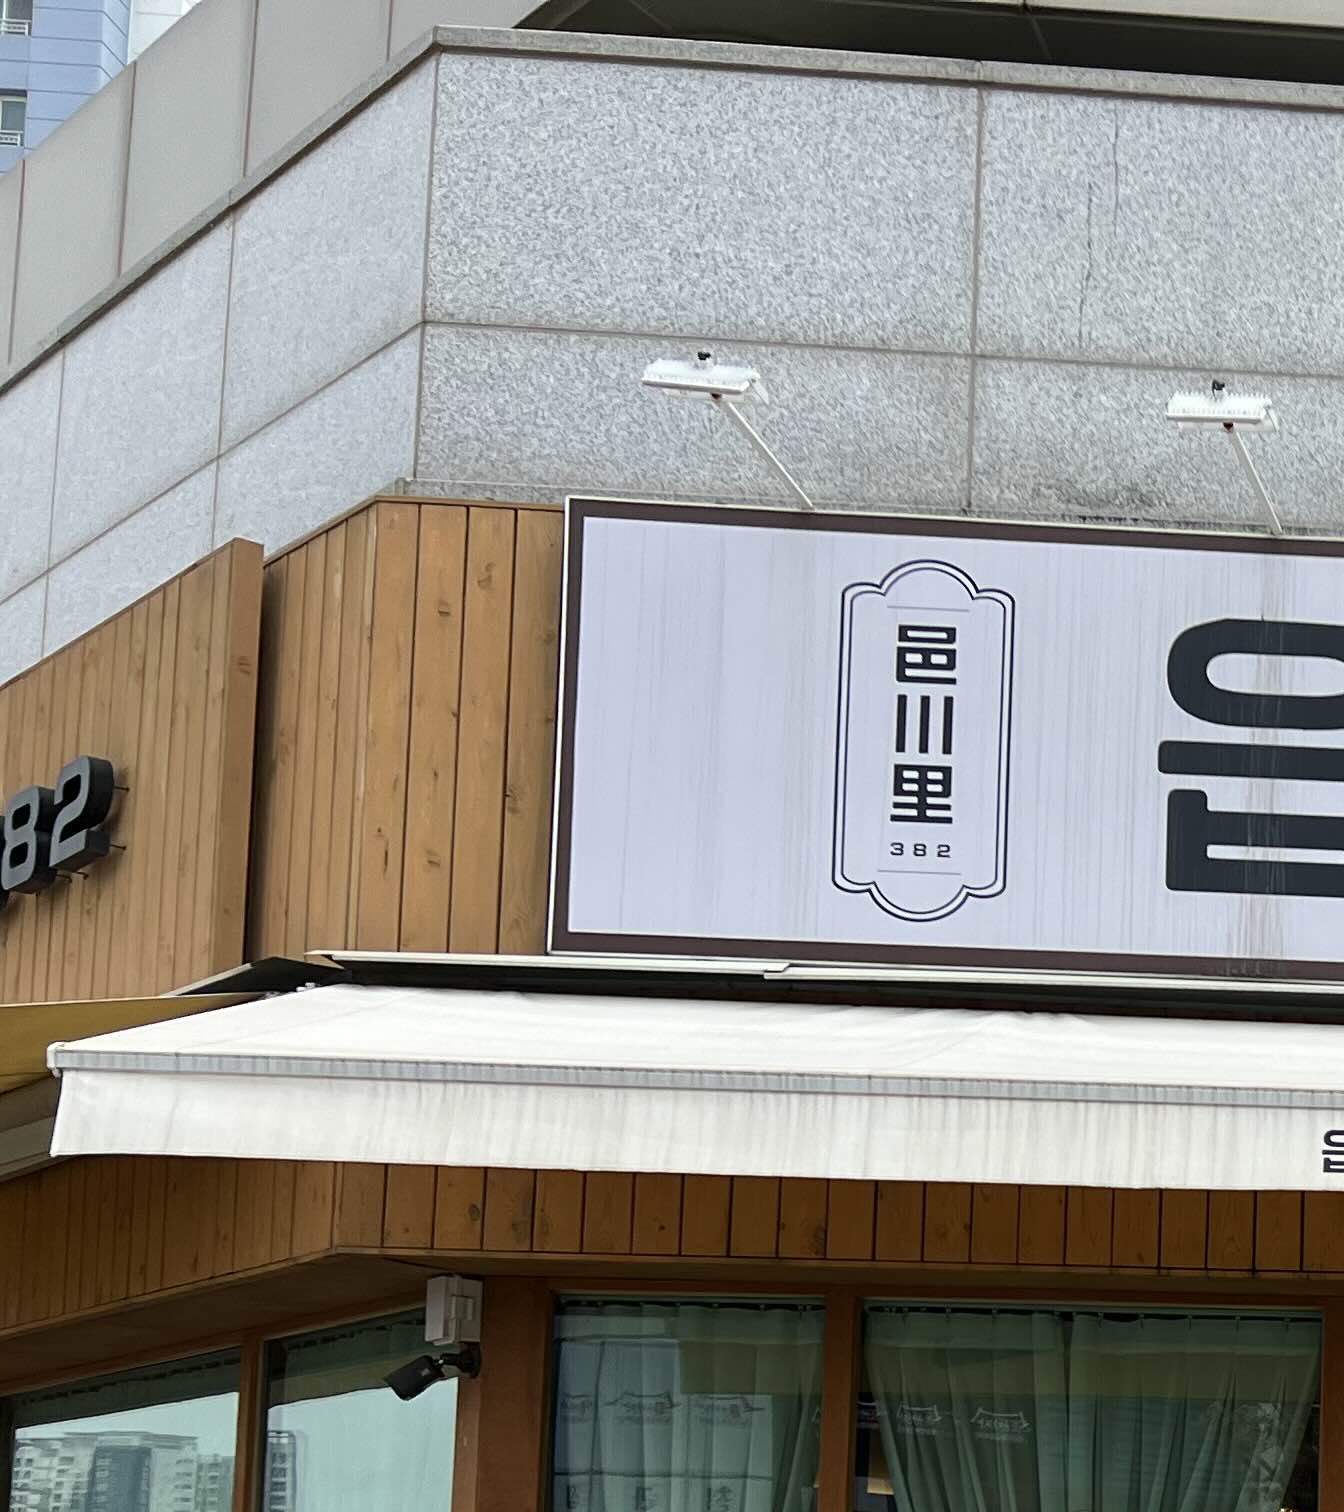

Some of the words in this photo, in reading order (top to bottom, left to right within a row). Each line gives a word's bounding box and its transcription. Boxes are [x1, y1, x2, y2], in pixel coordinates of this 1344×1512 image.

[890, 623, 957, 825] 邑川里
[889, 841, 952, 860] 382
